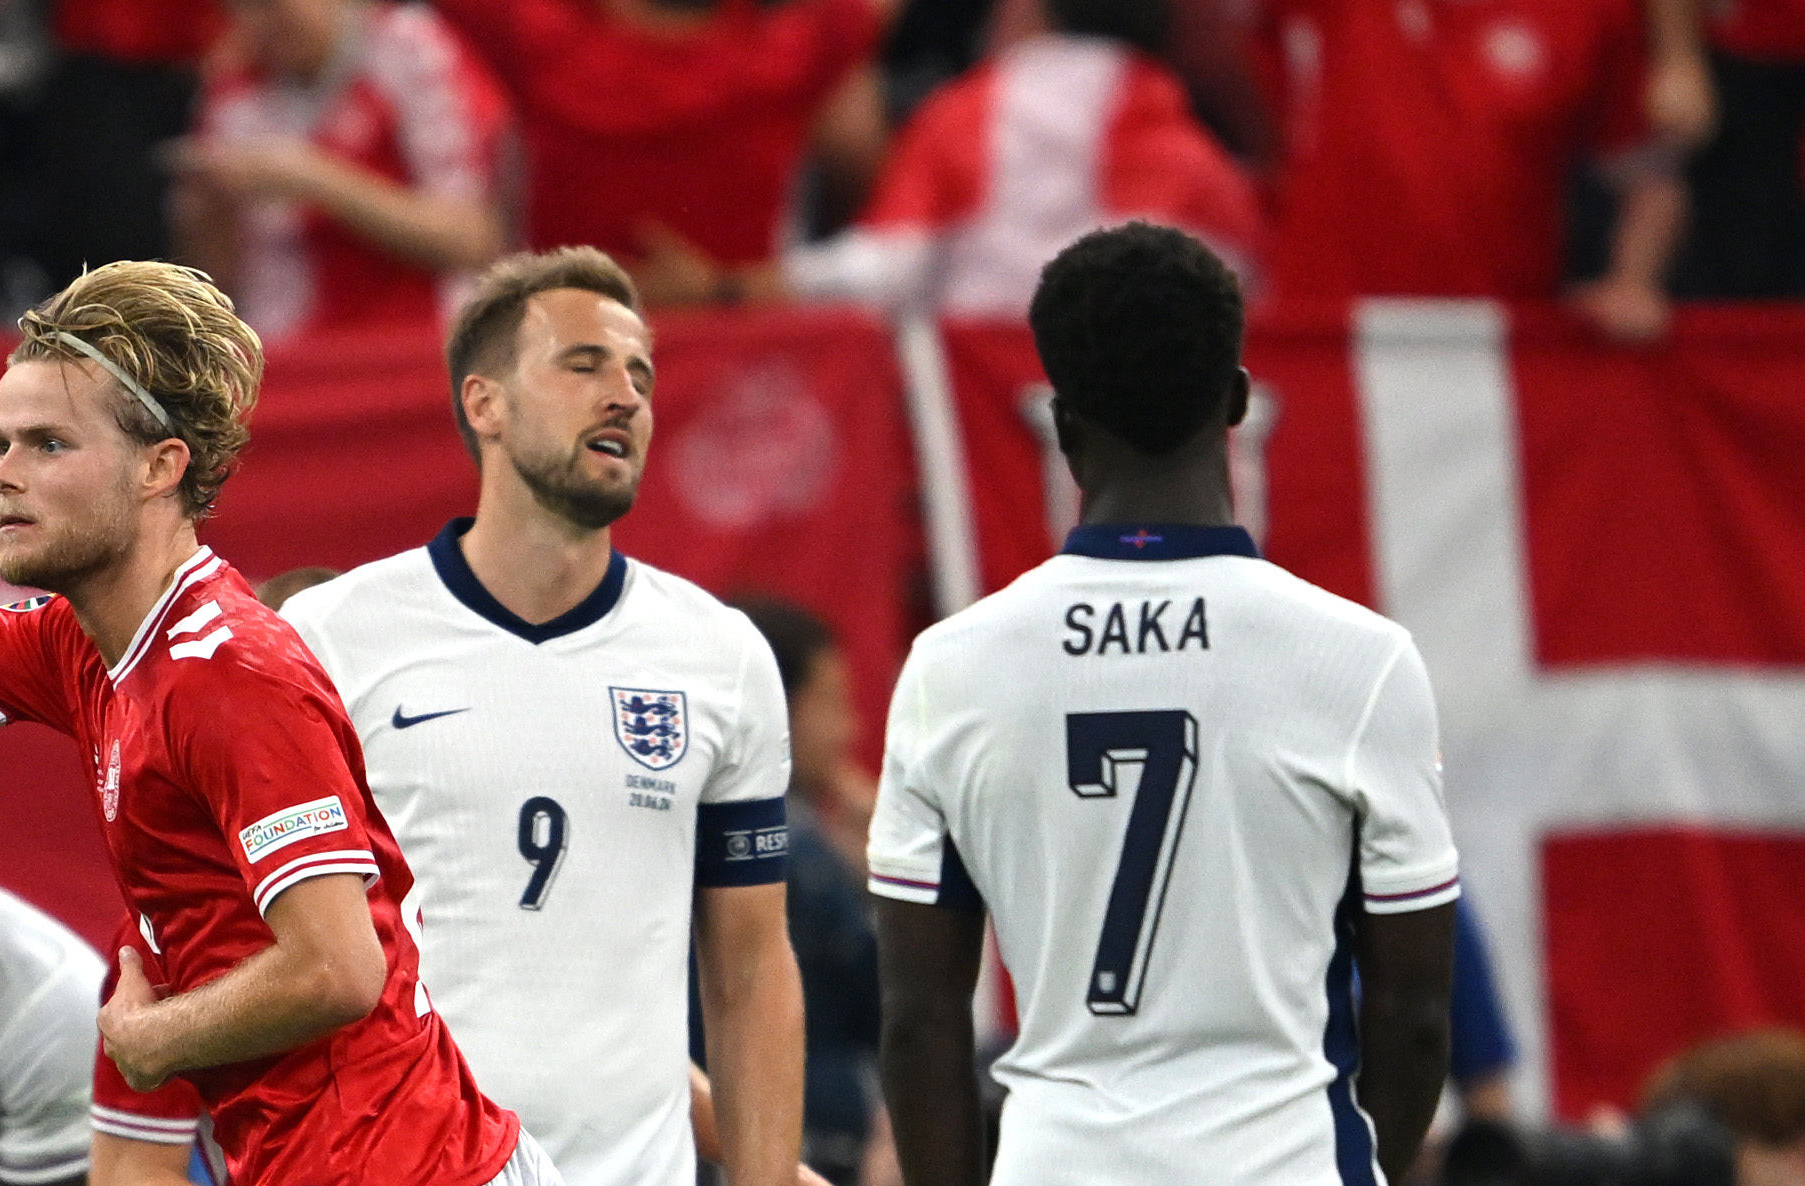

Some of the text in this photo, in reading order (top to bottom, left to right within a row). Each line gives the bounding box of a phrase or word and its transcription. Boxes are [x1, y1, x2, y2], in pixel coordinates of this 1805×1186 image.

[1062, 597, 1211, 656] SAKA
[242, 825, 262, 840] UEFA
[245, 806, 342, 852] FOUNDATION
[518, 796, 571, 911] 9
[1065, 709, 1200, 1016] 7
